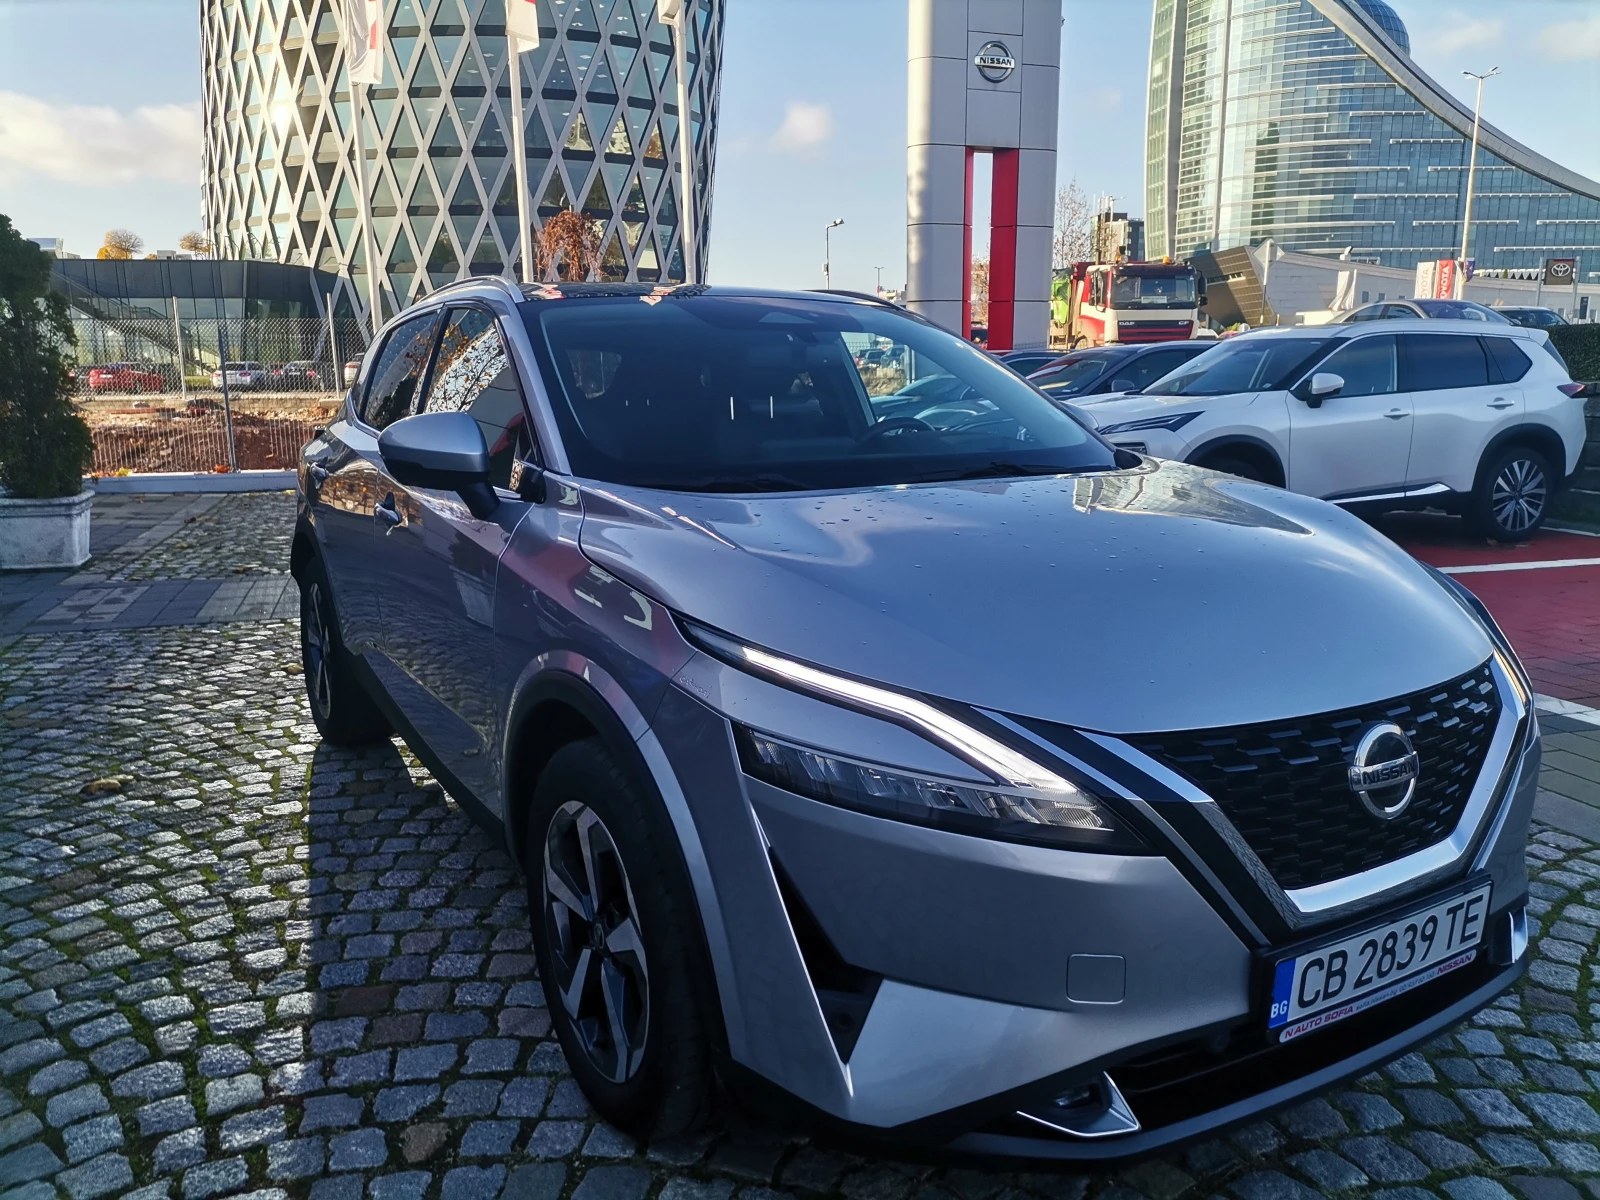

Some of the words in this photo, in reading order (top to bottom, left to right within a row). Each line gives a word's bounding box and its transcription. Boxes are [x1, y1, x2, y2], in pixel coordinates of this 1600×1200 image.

[979, 56, 1012, 66] NISSAN
[1421, 268, 1430, 299] OYOTA
[1439, 265, 1450, 299] OYOTA
[1362, 760, 1416, 785] NISSAN
[1297, 949, 1348, 1009] CB
[1353, 914, 1439, 991] 2839
[1446, 893, 1484, 951] TE
[1437, 953, 1473, 975] NISSAN
[1270, 1000, 1288, 1019] BG
[1324, 1006, 1353, 1023] SOFIA
